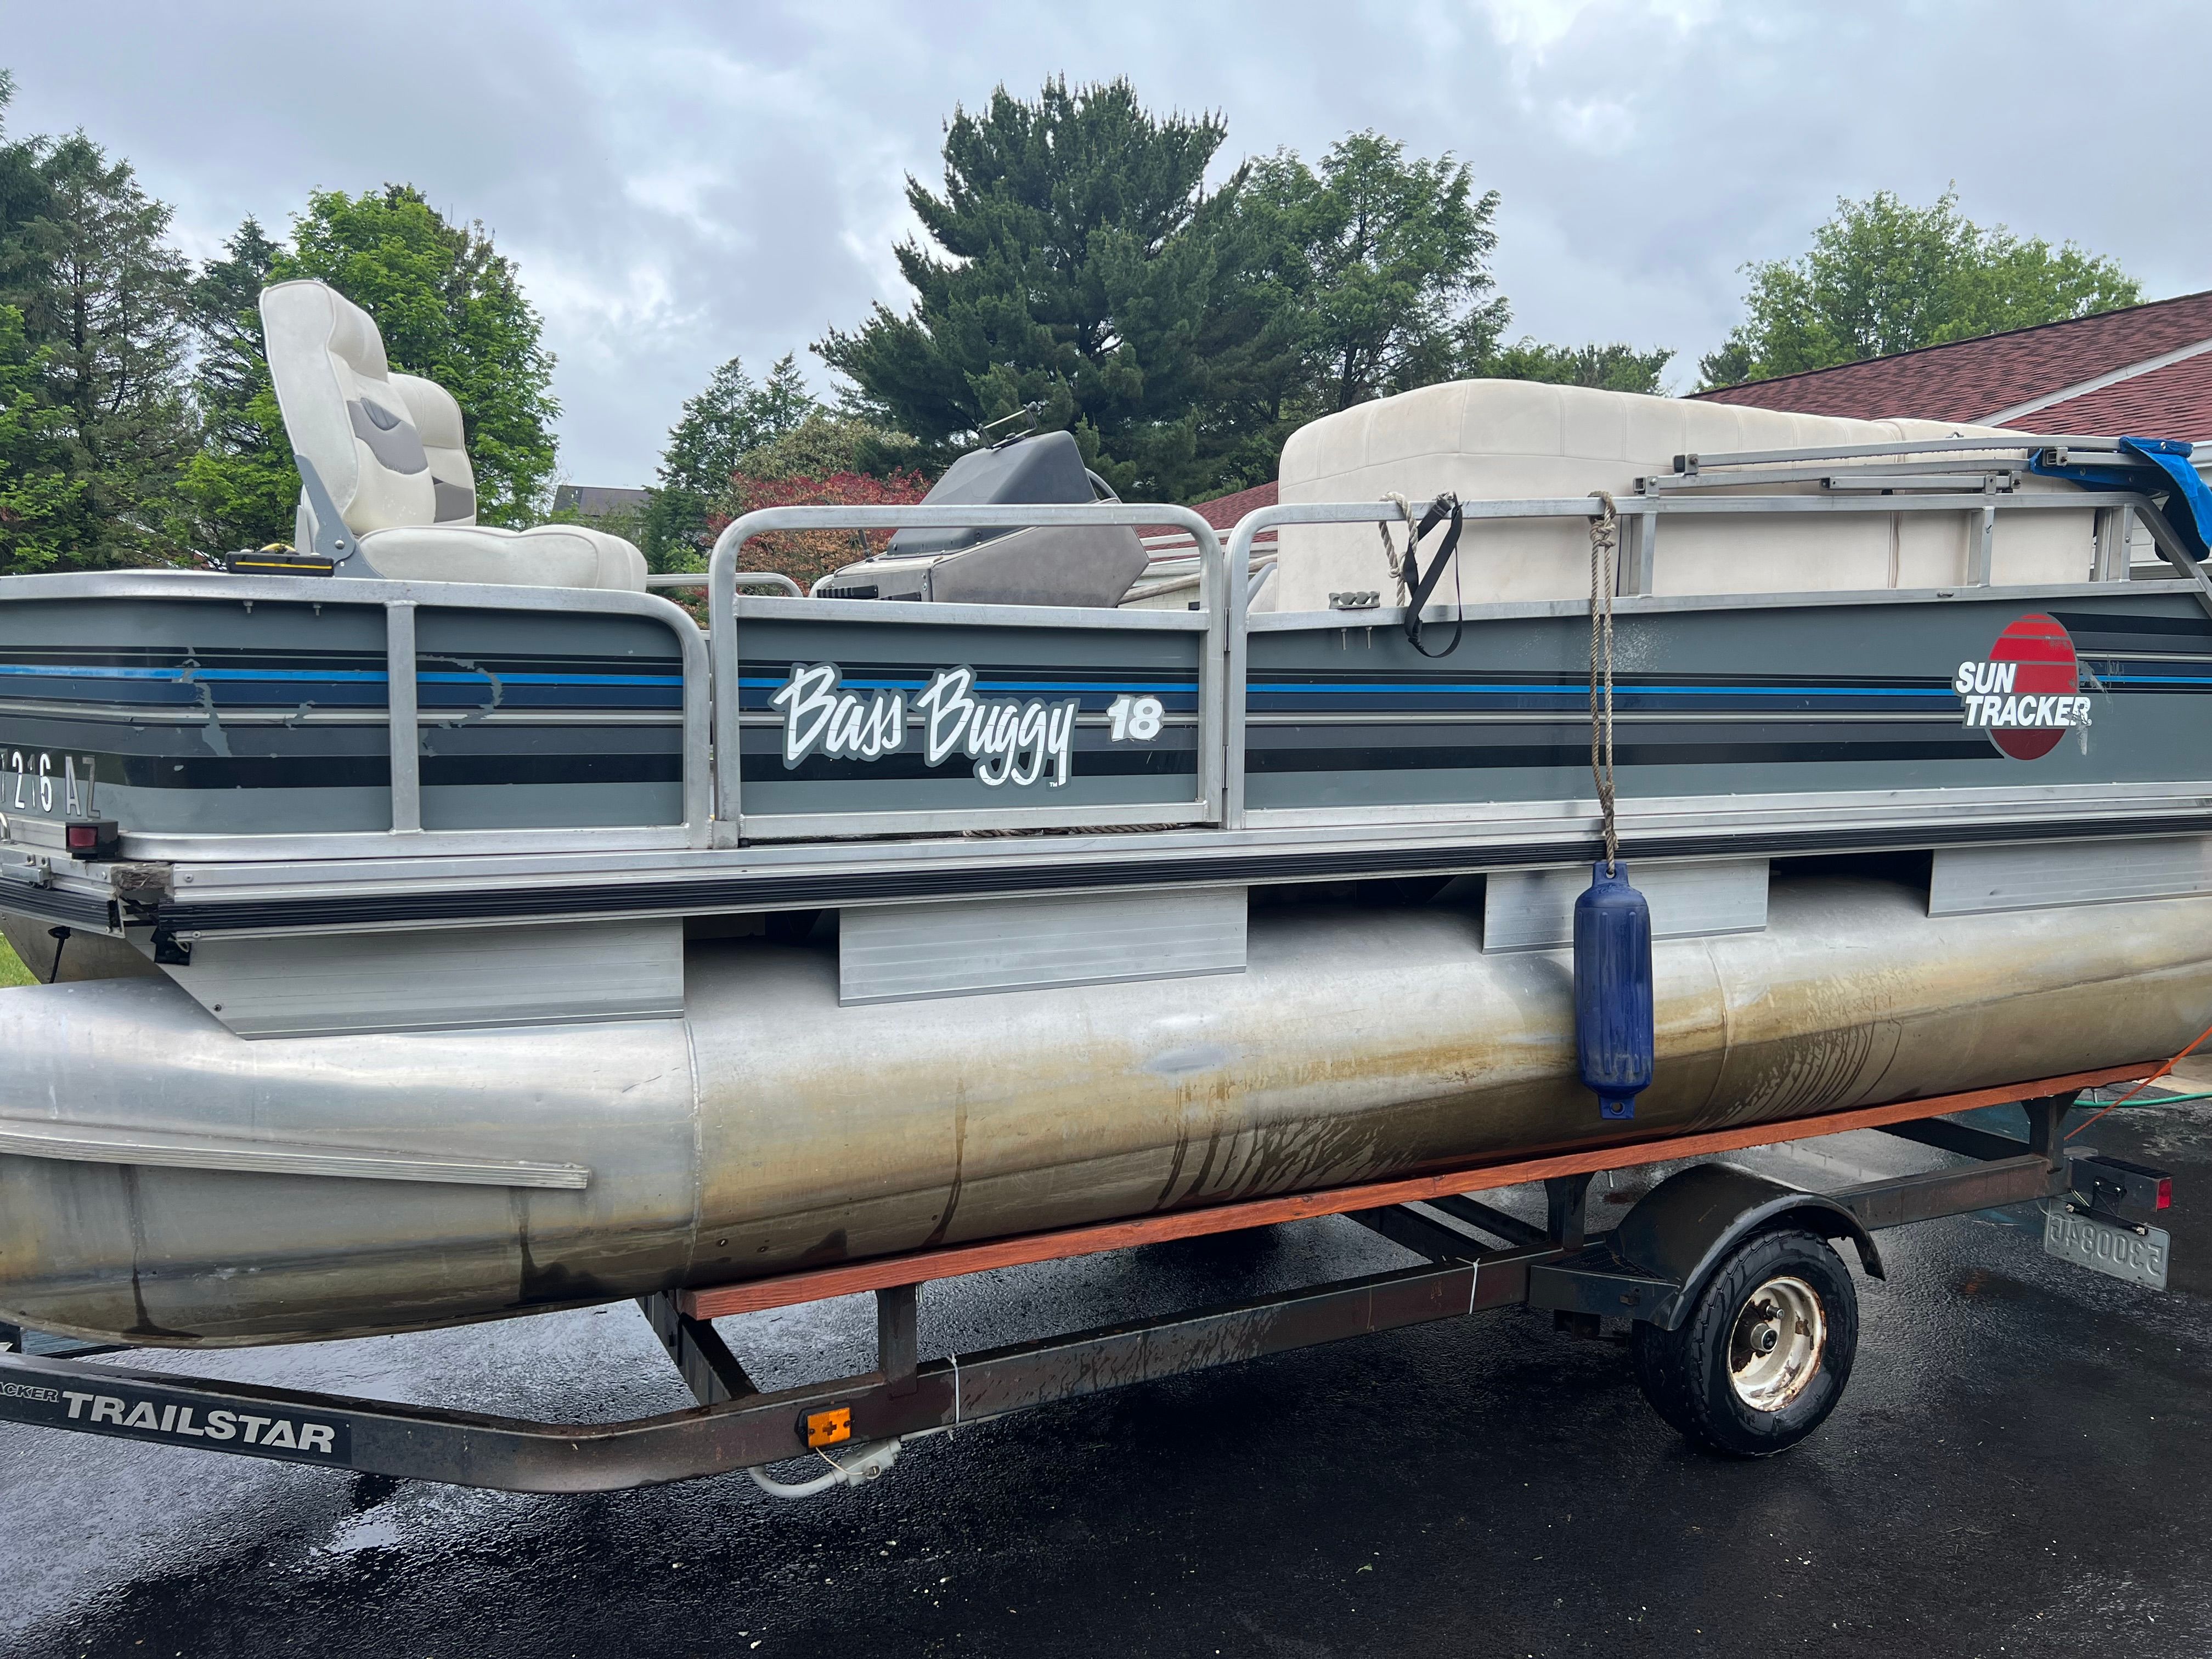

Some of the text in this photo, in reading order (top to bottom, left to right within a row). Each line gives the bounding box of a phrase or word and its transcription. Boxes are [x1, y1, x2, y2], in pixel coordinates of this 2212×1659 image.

[1956, 662, 2016, 693] SUN
[774, 665, 1164, 786] Bass Buggy 18
[1965, 695, 2092, 726] TRACKER
[65, 754, 101, 819] AZ
[0, 1381, 336, 1454] CKER TRAILSTAR
